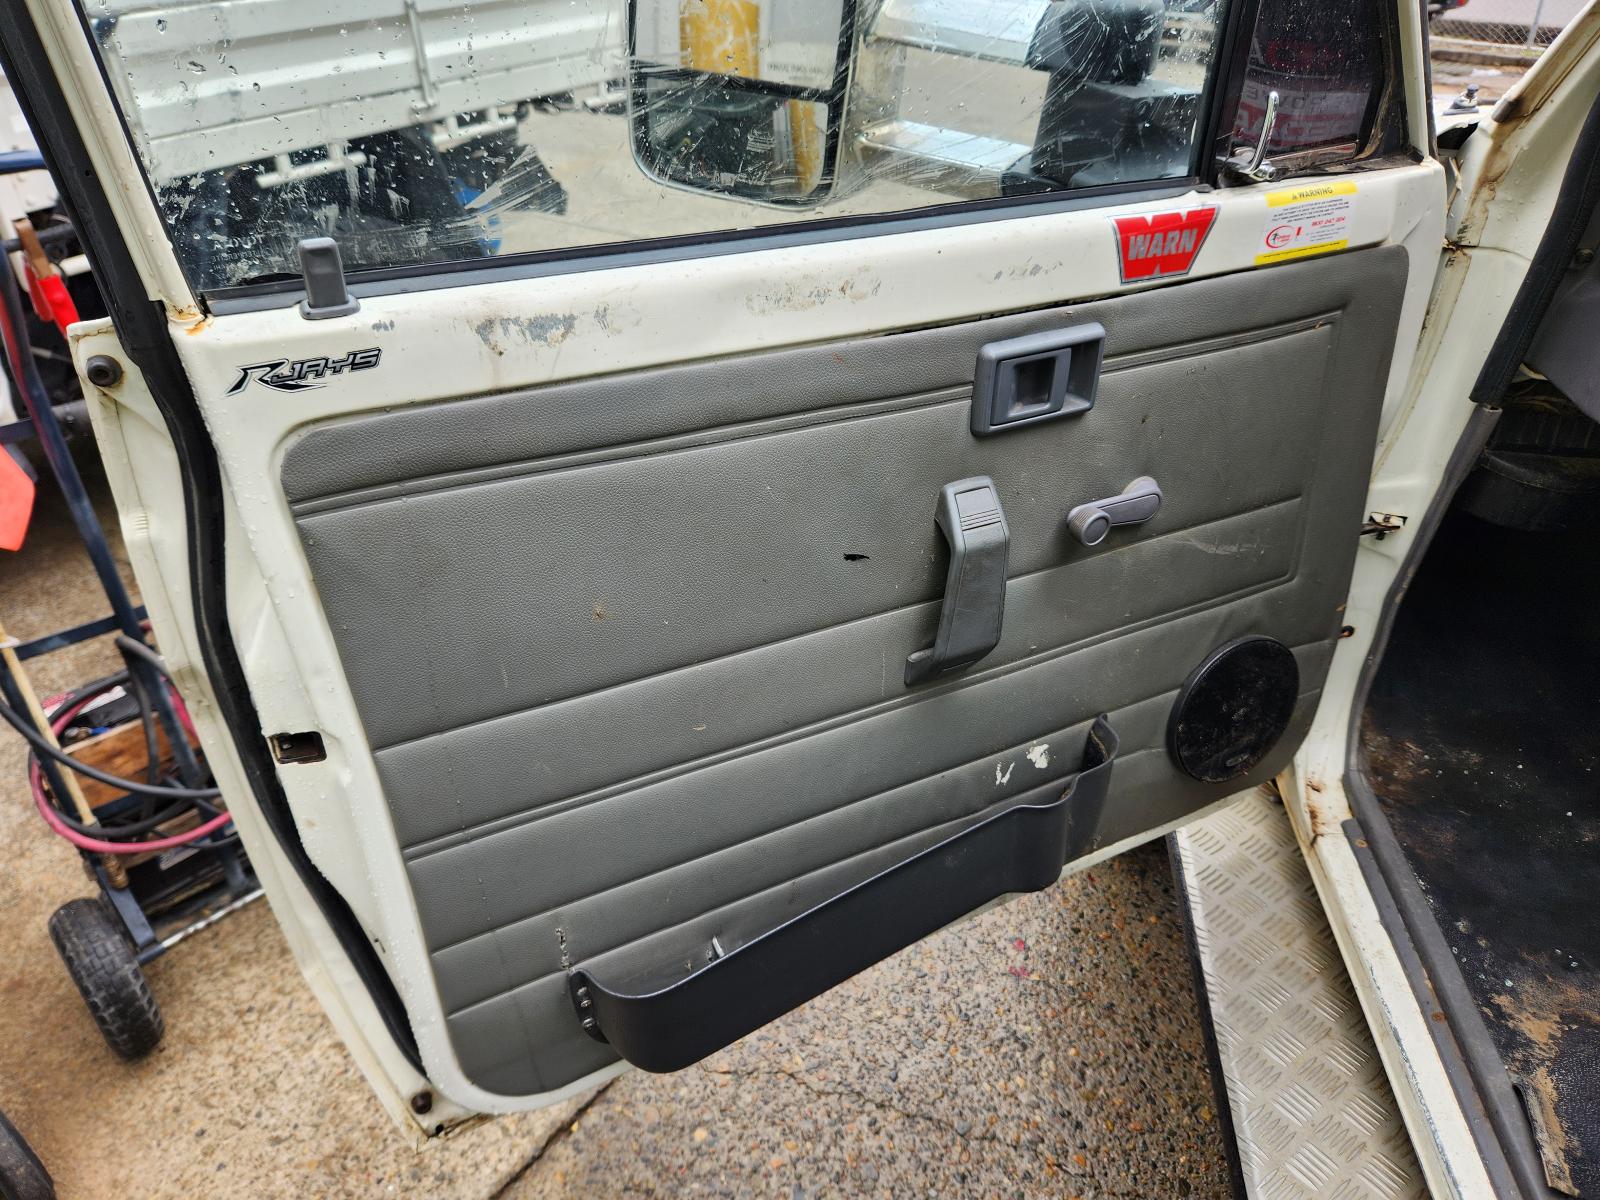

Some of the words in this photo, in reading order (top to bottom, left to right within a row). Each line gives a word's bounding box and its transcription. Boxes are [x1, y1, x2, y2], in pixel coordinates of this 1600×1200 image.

[1299, 187, 1333, 198] WARNING
[1128, 229, 1198, 260] WARN
[225, 347, 381, 396] RJAYS
